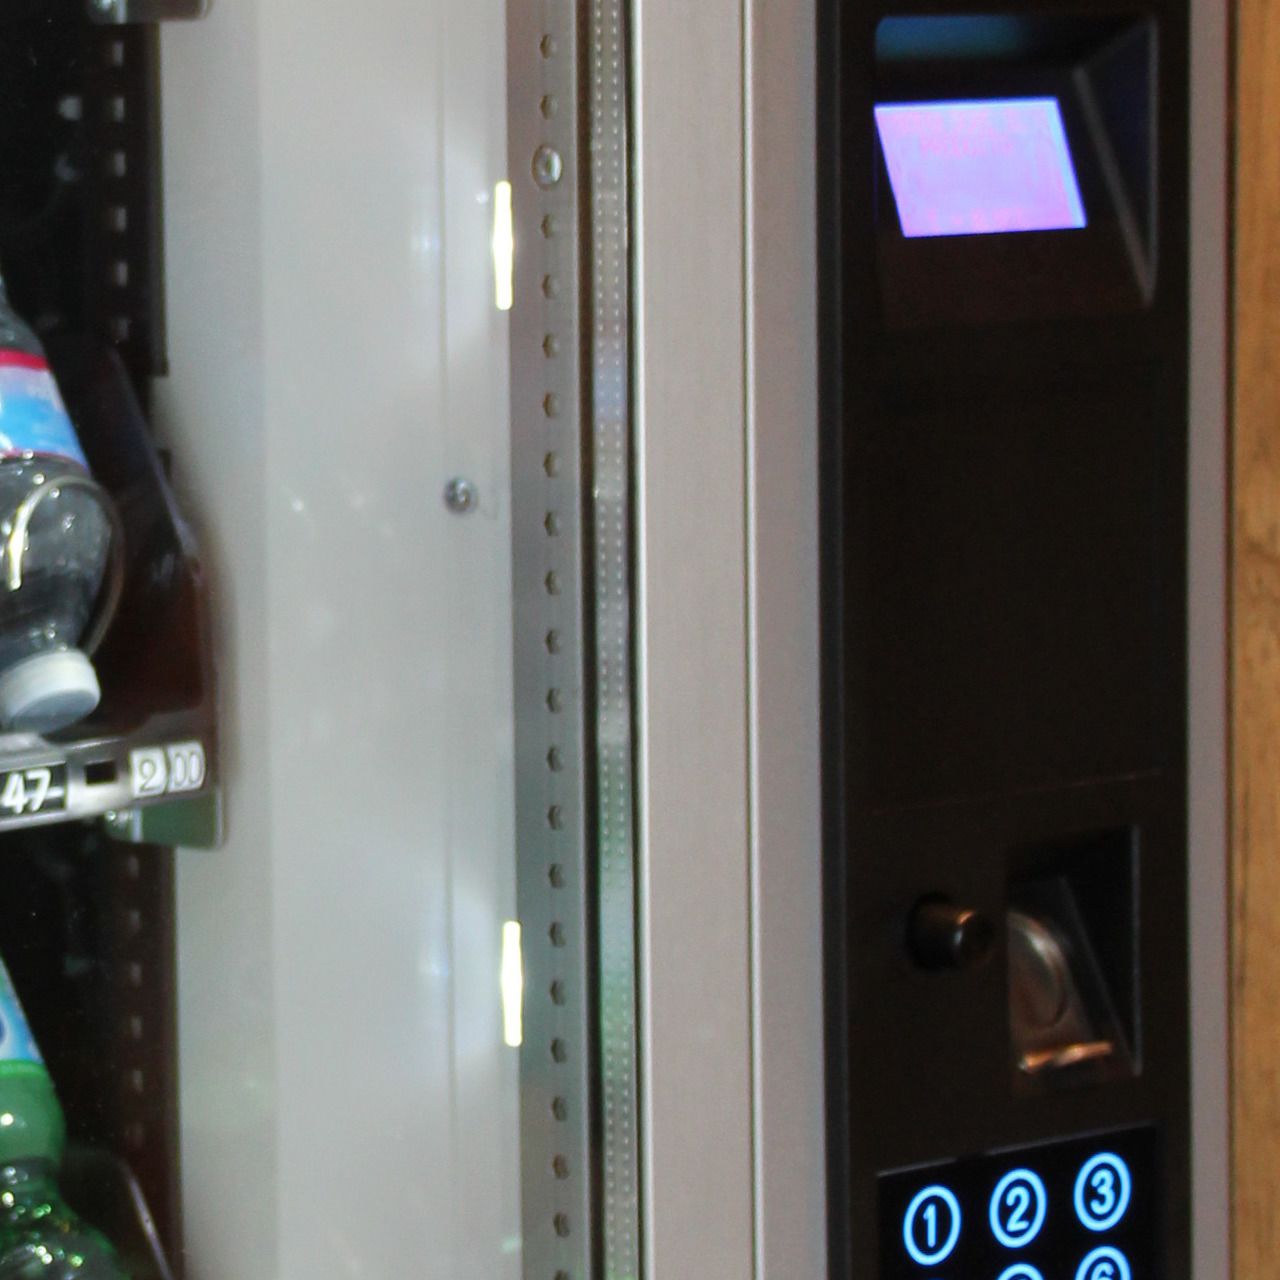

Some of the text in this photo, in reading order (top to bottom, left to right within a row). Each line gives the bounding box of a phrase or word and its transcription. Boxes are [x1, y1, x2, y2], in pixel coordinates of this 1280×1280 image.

[0, 766, 52, 815] 47
[1005, 1186, 1031, 1231] 2
[1089, 1168, 1116, 1216] 3
[923, 1202, 937, 1249] 1
